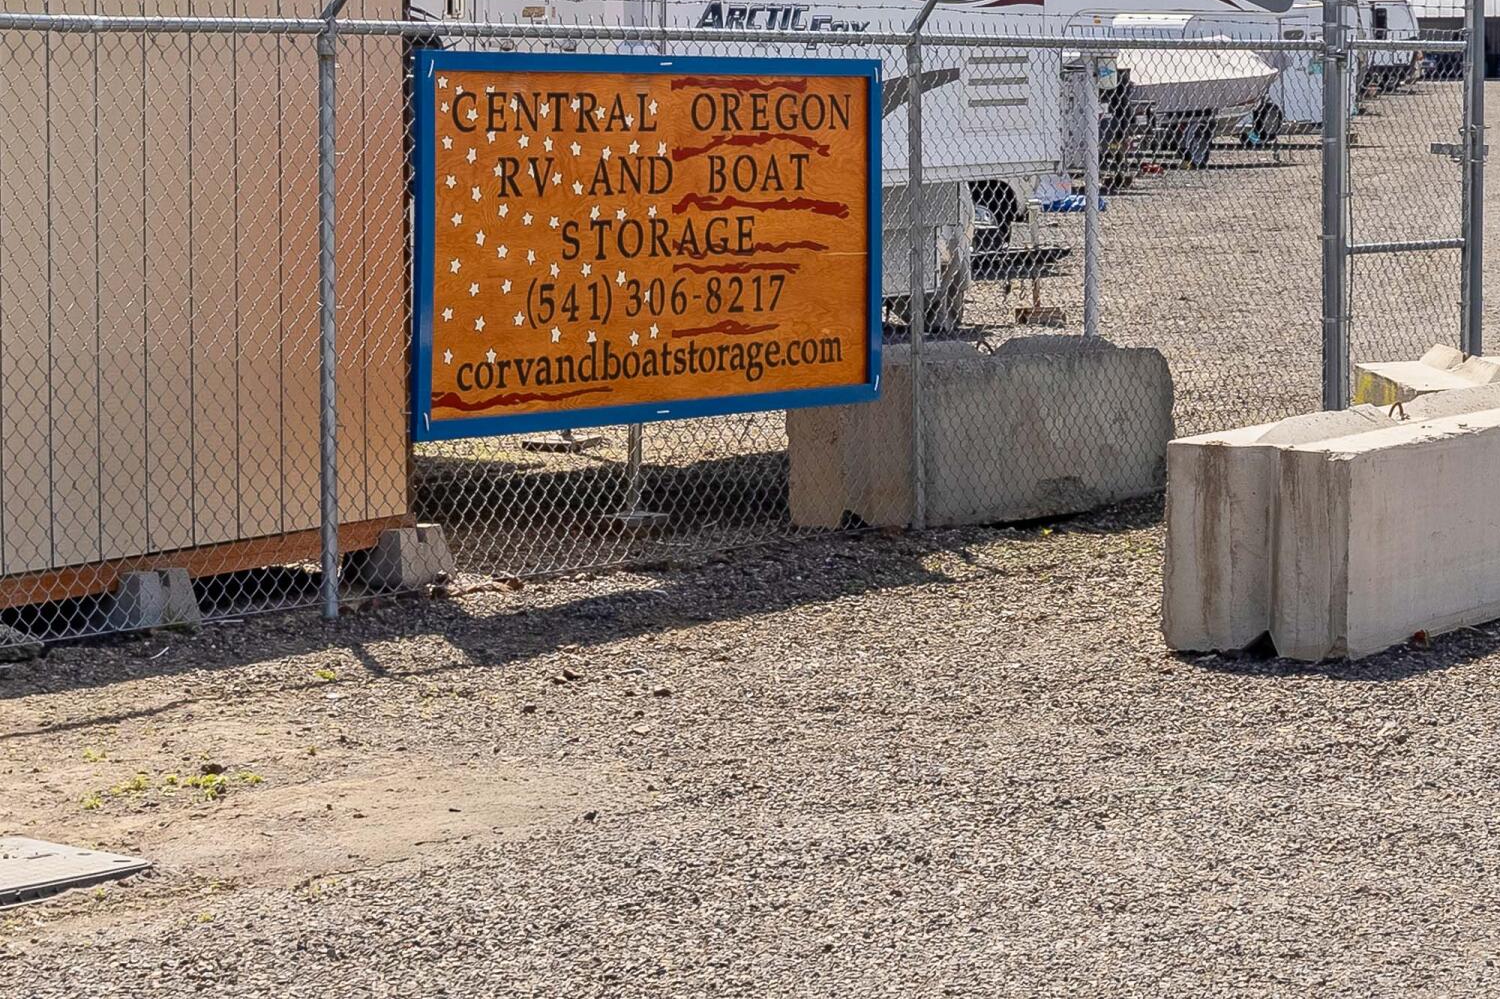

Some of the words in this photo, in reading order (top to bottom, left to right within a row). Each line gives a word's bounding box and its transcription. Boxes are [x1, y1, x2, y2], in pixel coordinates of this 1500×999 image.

[696, 0, 809, 31] ARCTIC
[452, 91, 658, 133] CENTRAL
[690, 93, 851, 131] OREGON
[497, 156, 555, 198] RV
[588, 155, 674, 196] AND
[708, 153, 810, 194] BOAT
[561, 216, 756, 261] STORAGE
[526, 274, 613, 330] (541)
[625, 274, 786, 317] 306-8217
[456, 336, 843, 392] corvandboatstorage.com
